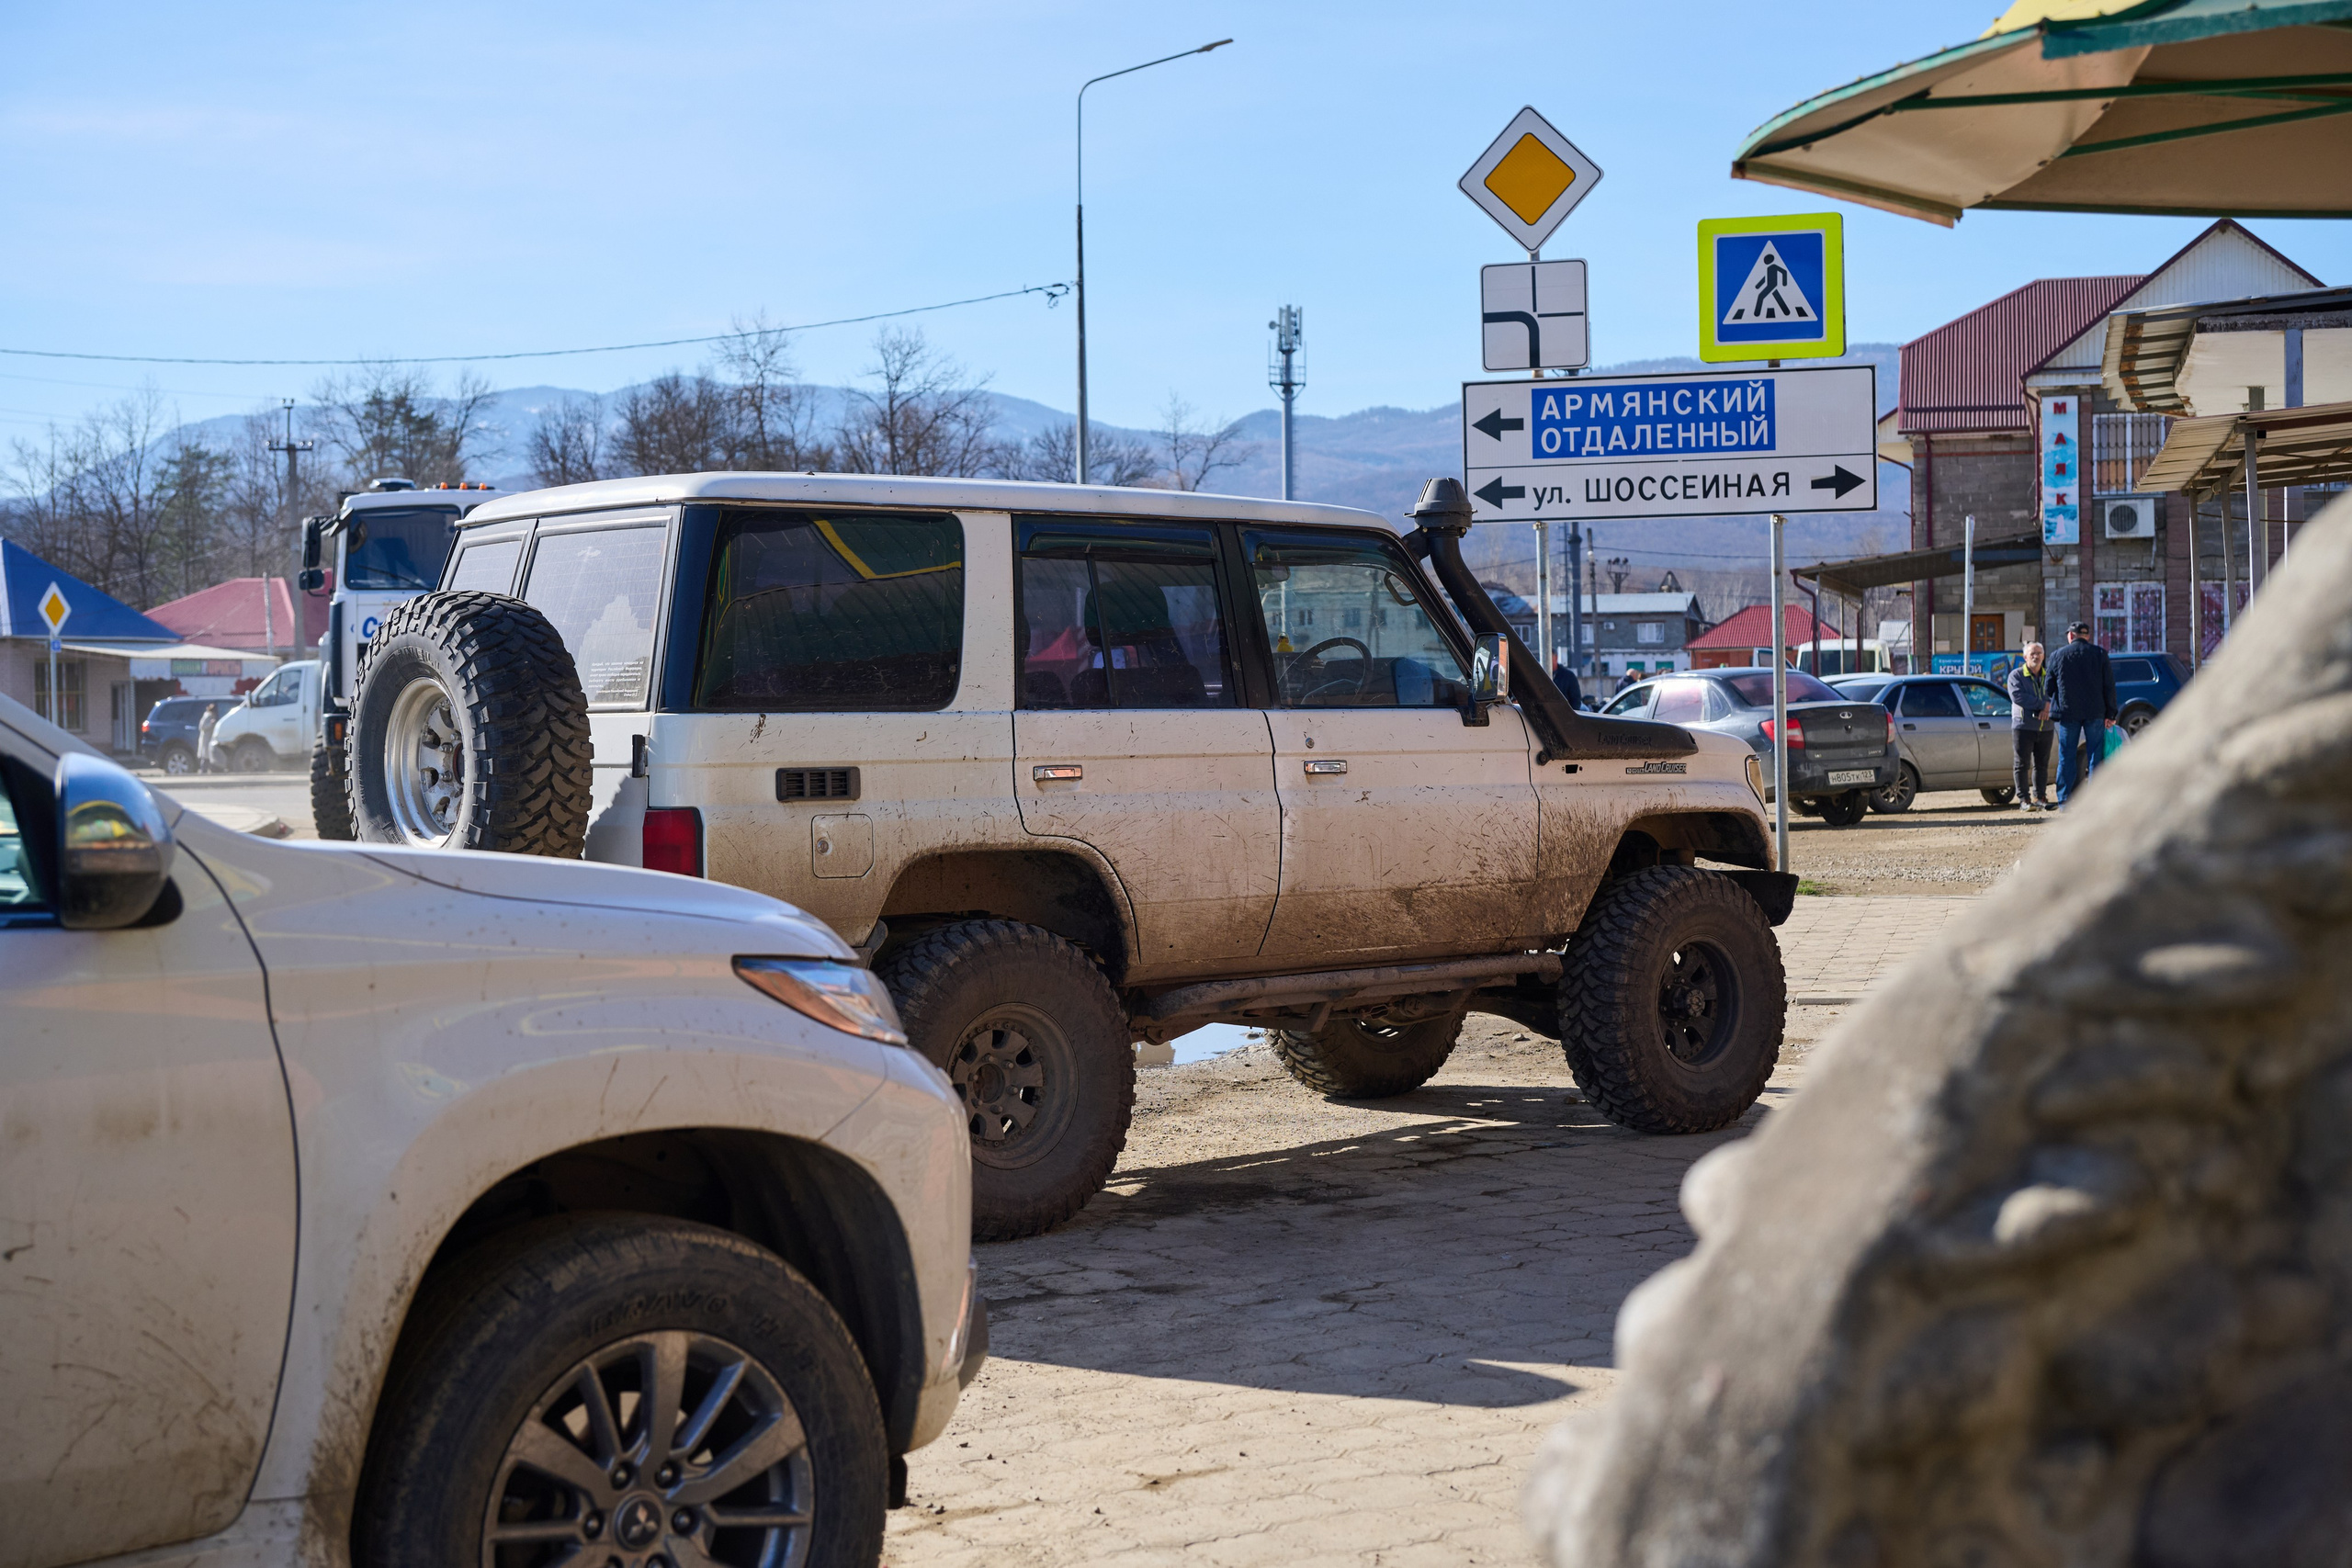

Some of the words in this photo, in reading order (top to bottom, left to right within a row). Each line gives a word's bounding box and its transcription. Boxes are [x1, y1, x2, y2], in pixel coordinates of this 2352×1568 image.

[1540, 379, 1766, 421] АРМЯНСКИЙ
[1540, 413, 1769, 456] ОТДАЛЕННЫЙ
[2052, 401, 2067, 505] МАЯК
[1532, 486, 1572, 512] ул.
[1644, 761, 1662, 773] LAND
[1661, 761, 1687, 773] CRUISER
